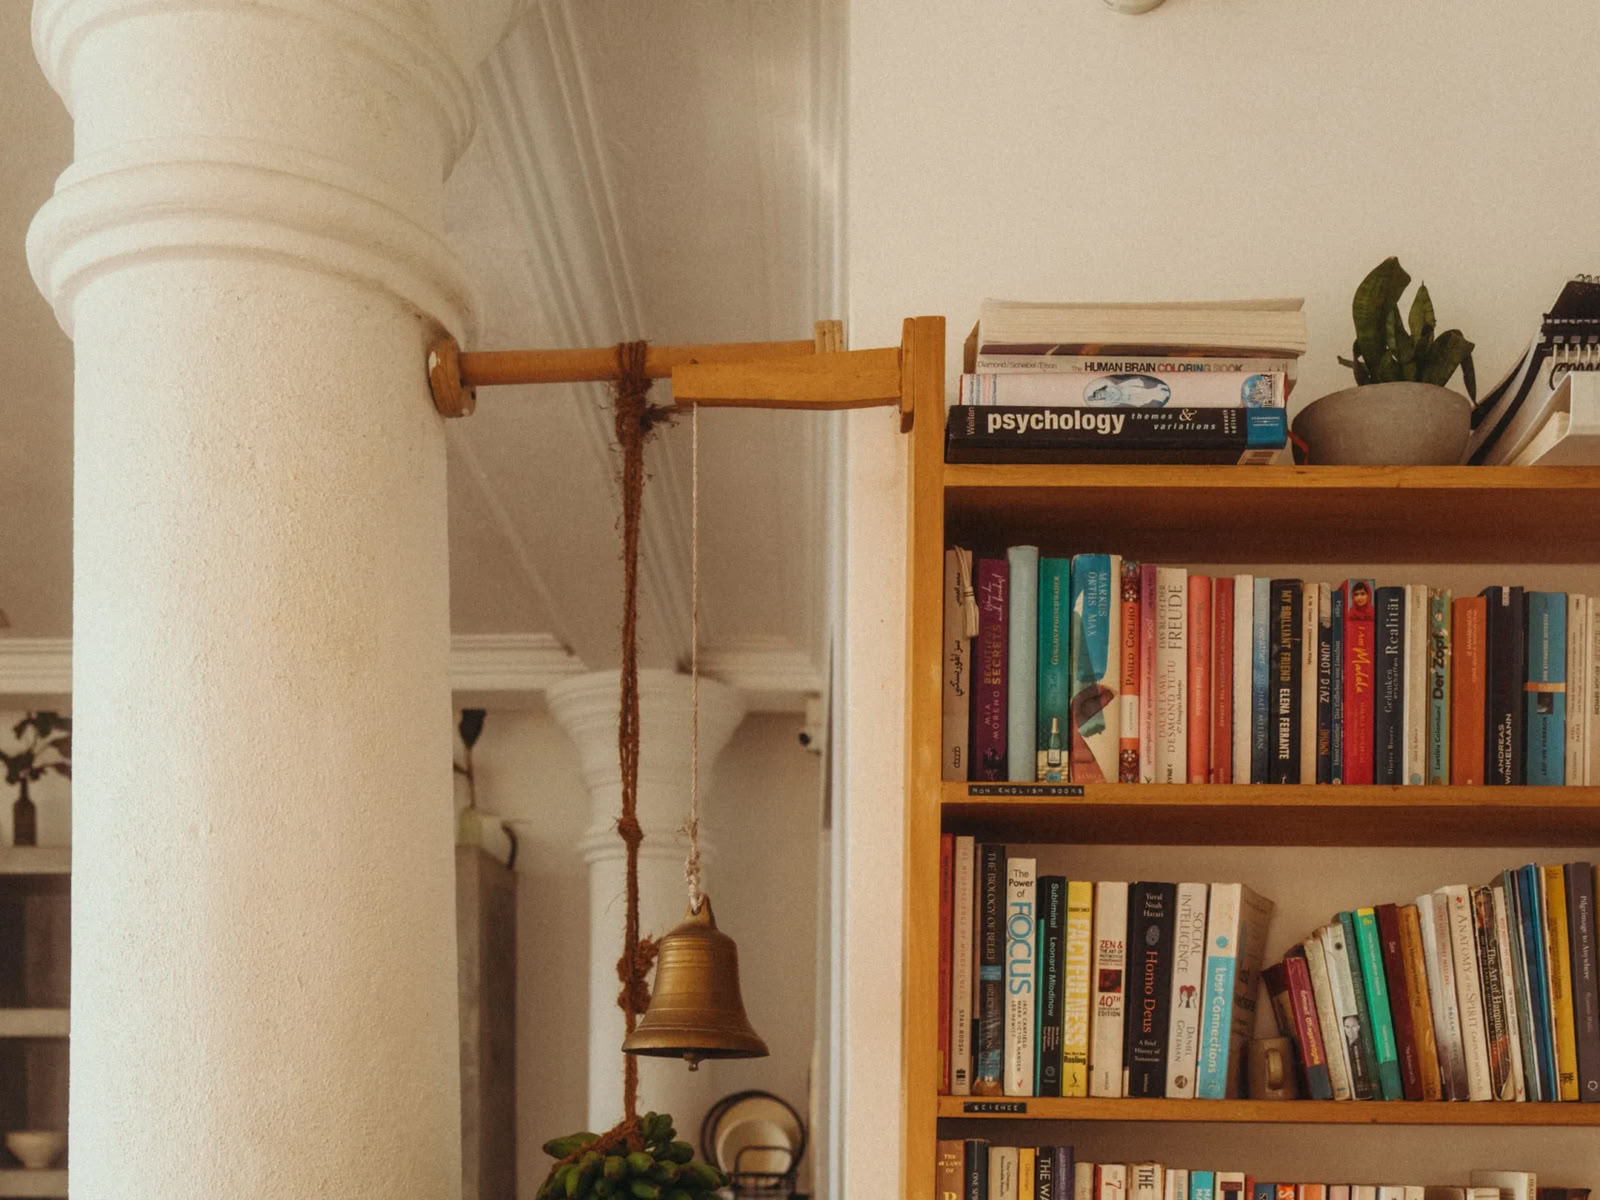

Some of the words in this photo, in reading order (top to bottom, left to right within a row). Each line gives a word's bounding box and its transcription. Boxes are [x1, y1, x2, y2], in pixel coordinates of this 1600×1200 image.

[1084, 362, 1122, 372] HUMAN
[1125, 363, 1155, 372] BRAIN
[966, 407, 975, 435] Weiten
[987, 409, 1125, 435] psychology
[1179, 409, 1197, 421] &
[1088, 572, 1097, 606] ORTHS
[1098, 572, 1107, 617] MARKUS
[1281, 590, 1291, 603] MY
[1088, 614, 1097, 637] MAX
[1125, 606, 1135, 648] COELHO
[1168, 585, 1182, 649] FREUDE
[1280, 606, 1291, 649] BRILLIANT
[1385, 598, 1400, 654] Realität
[992, 625, 1000, 685] SECRETS
[1125, 653, 1135, 686] PAULO
[1280, 652, 1291, 681] FRIEND
[1279, 688, 1291, 714] ELENA
[1384, 669, 1393, 713] Gedanken
[1279, 717, 1290, 760] FERRANTE
[1008, 879, 1033, 887] Power
[1013, 869, 1030, 878] The
[1049, 883, 1059, 928] Subliminal
[1143, 909, 1163, 917] Harari
[1146, 893, 1162, 901] Yuval
[1146, 901, 1162, 909] Noah
[1008, 902, 1033, 995] FOCUS
[1100, 940, 1116, 948] ZEN
[1177, 894, 1192, 973] INTELLIGENCE
[1191, 911, 1203, 956] SOCIAL
[1049, 937, 1058, 972] Leonard
[1065, 918, 1090, 1046] FACTFULNESS
[1144, 951, 1157, 994] Homo
[1214, 967, 1228, 994] Lost
[1047, 975, 1056, 1016] Mlodinow
[1143, 999, 1156, 1033] Deus
[1208, 996, 1225, 1073] Connections
[1039, 1157, 1050, 1180] THE
[1138, 1168, 1154, 1190] THE
